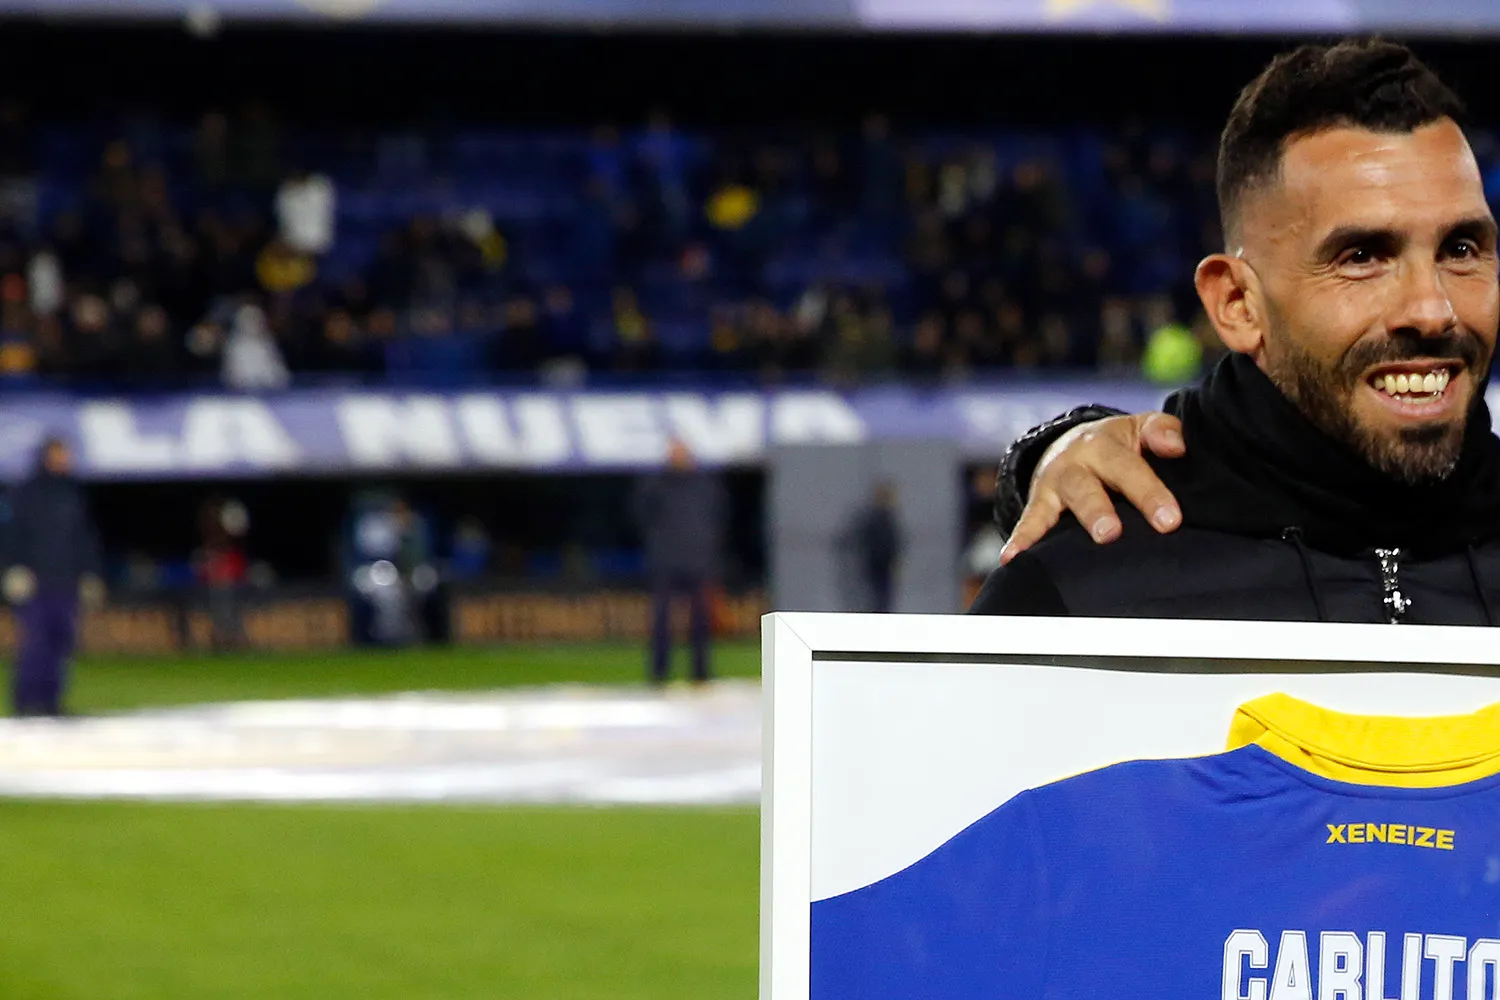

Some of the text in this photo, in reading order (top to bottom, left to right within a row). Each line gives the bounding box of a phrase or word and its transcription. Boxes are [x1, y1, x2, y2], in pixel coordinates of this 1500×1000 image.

[80, 394, 868, 467] LA NUEVA
[1326, 823, 1455, 850] XENEIZE
